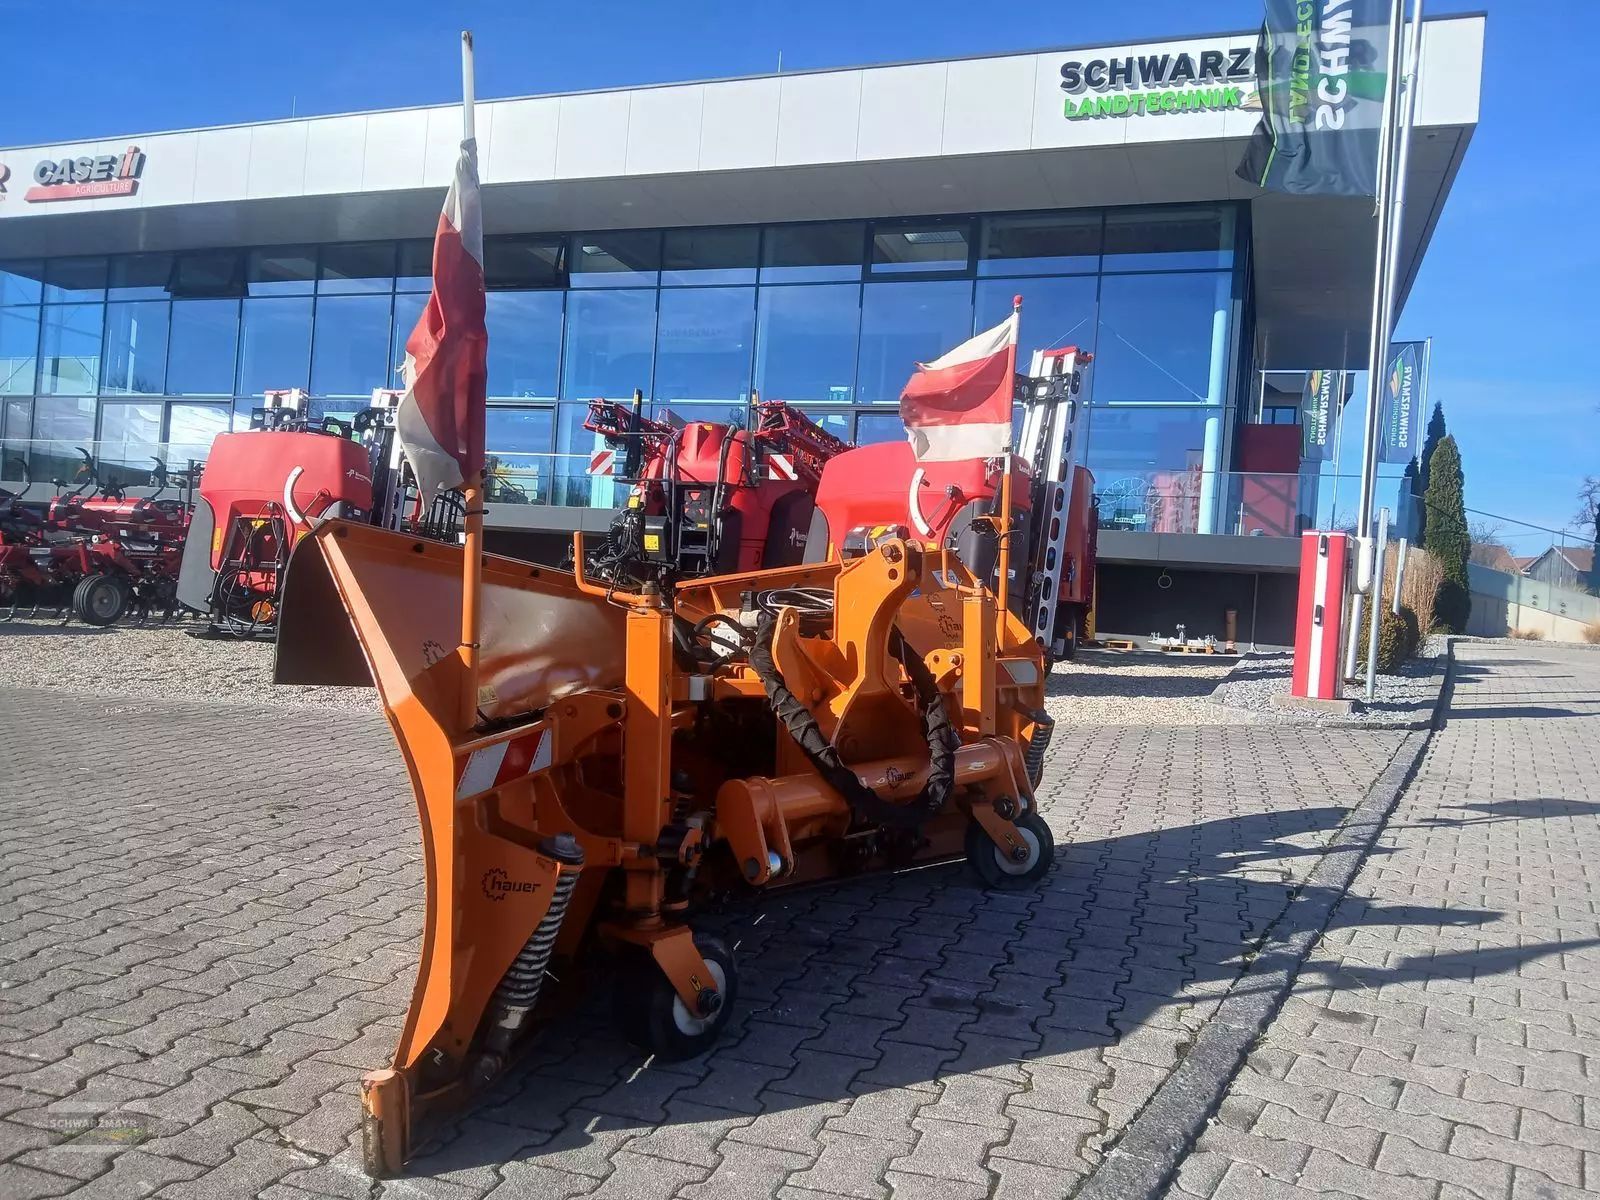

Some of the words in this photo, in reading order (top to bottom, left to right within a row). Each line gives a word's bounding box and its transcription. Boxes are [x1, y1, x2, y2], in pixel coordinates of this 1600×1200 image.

[1060, 47, 1258, 92] SCHWARZ
[1064, 86, 1241, 118] LANDTECHNIK
[33, 154, 116, 186] CASE
[75, 181, 130, 195] AGRICULTURE
